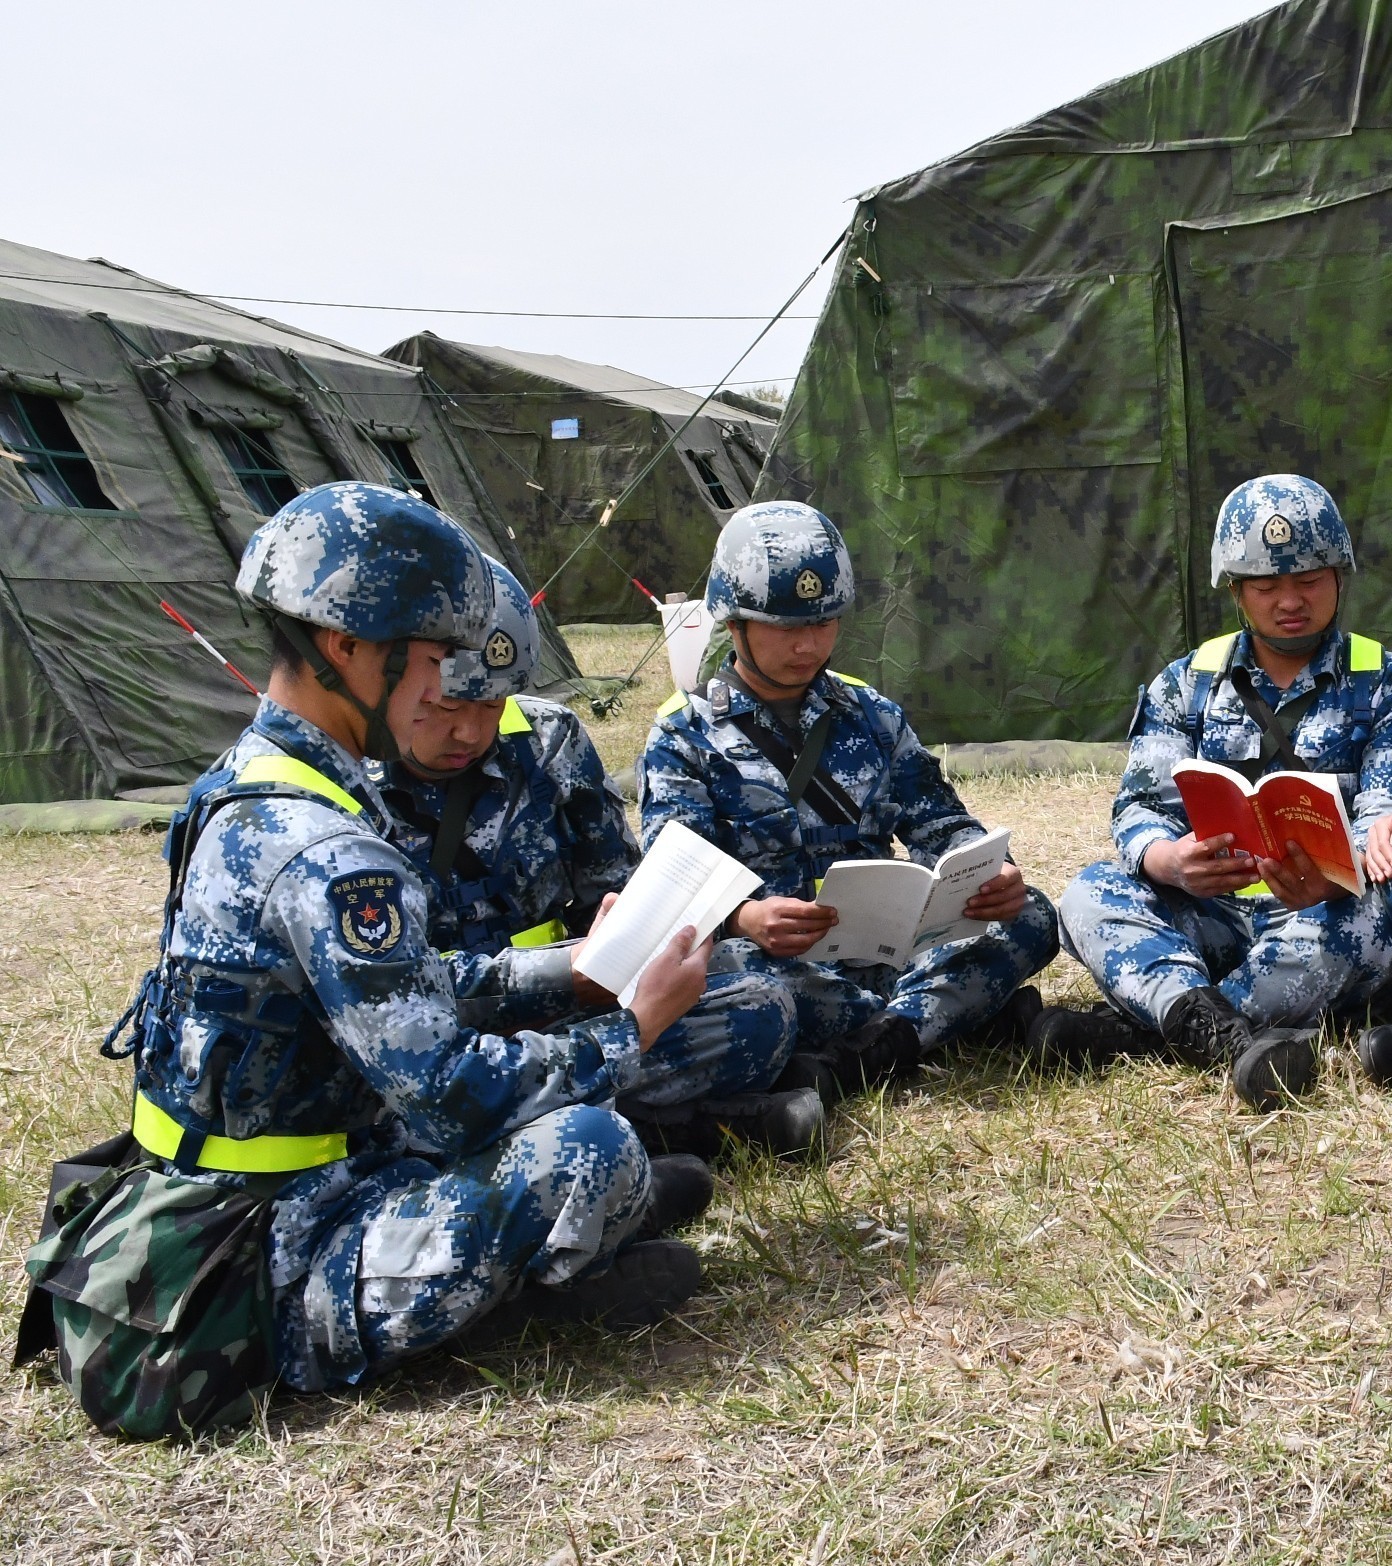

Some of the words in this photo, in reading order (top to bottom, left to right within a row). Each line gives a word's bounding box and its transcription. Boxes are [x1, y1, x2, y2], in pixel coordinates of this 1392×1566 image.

[334, 877, 394, 895] 中国人民解放军
